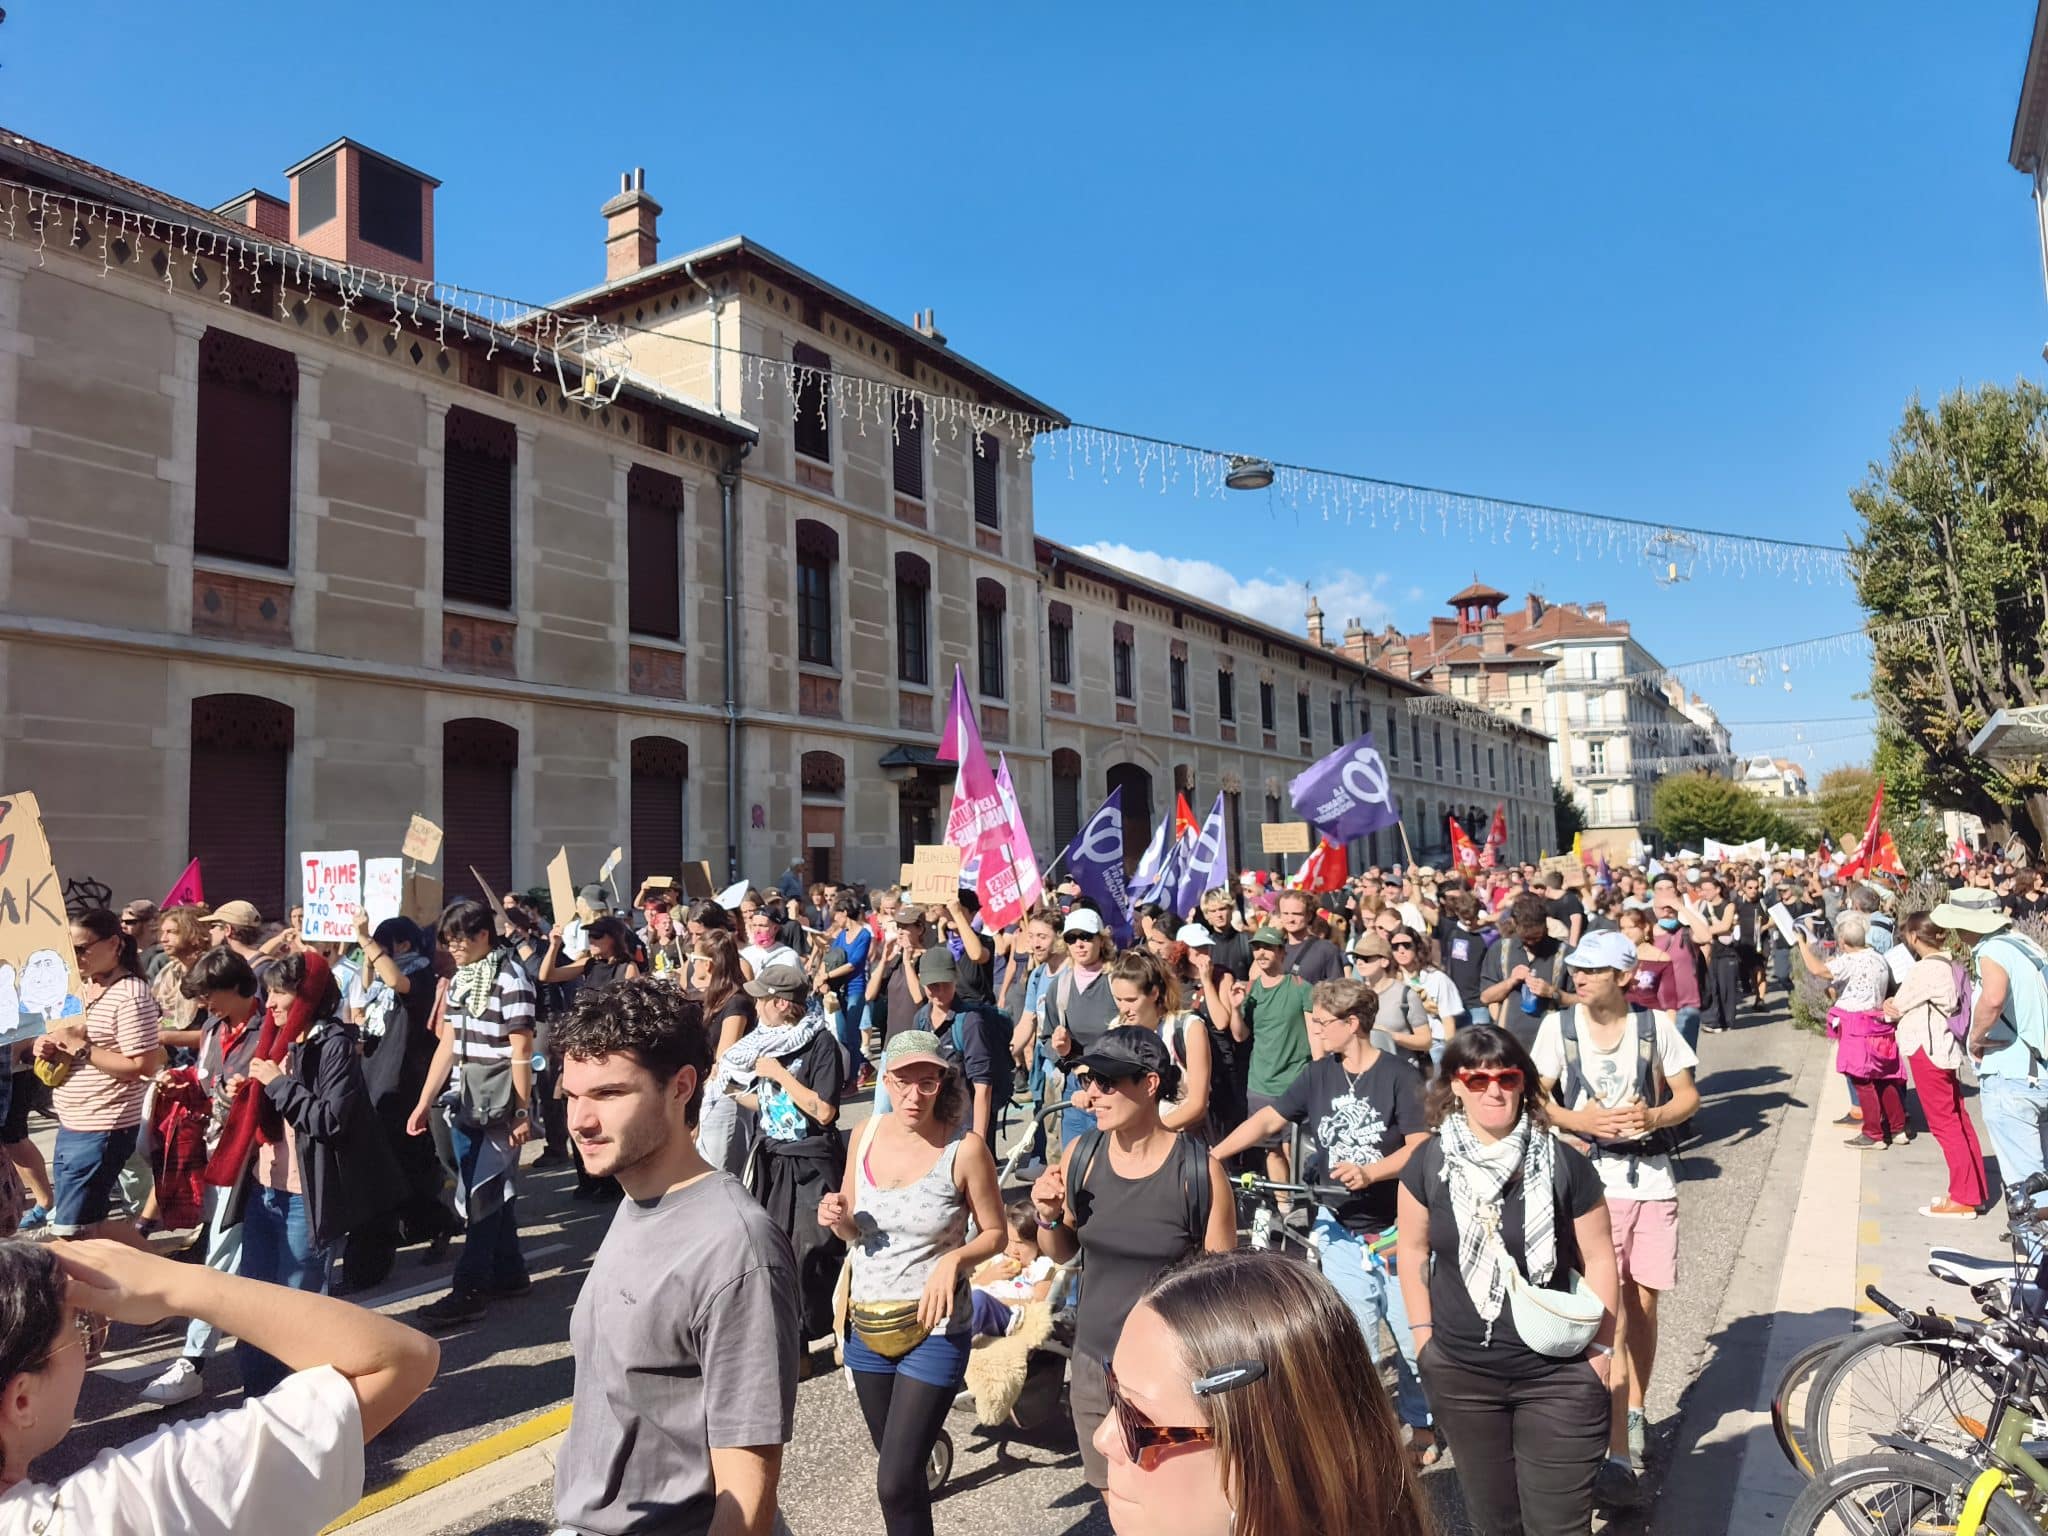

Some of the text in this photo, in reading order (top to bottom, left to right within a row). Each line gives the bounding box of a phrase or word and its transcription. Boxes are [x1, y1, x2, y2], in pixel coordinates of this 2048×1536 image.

[306, 859, 357, 895] J'AIME
[304, 917, 354, 936] LA POLICE
